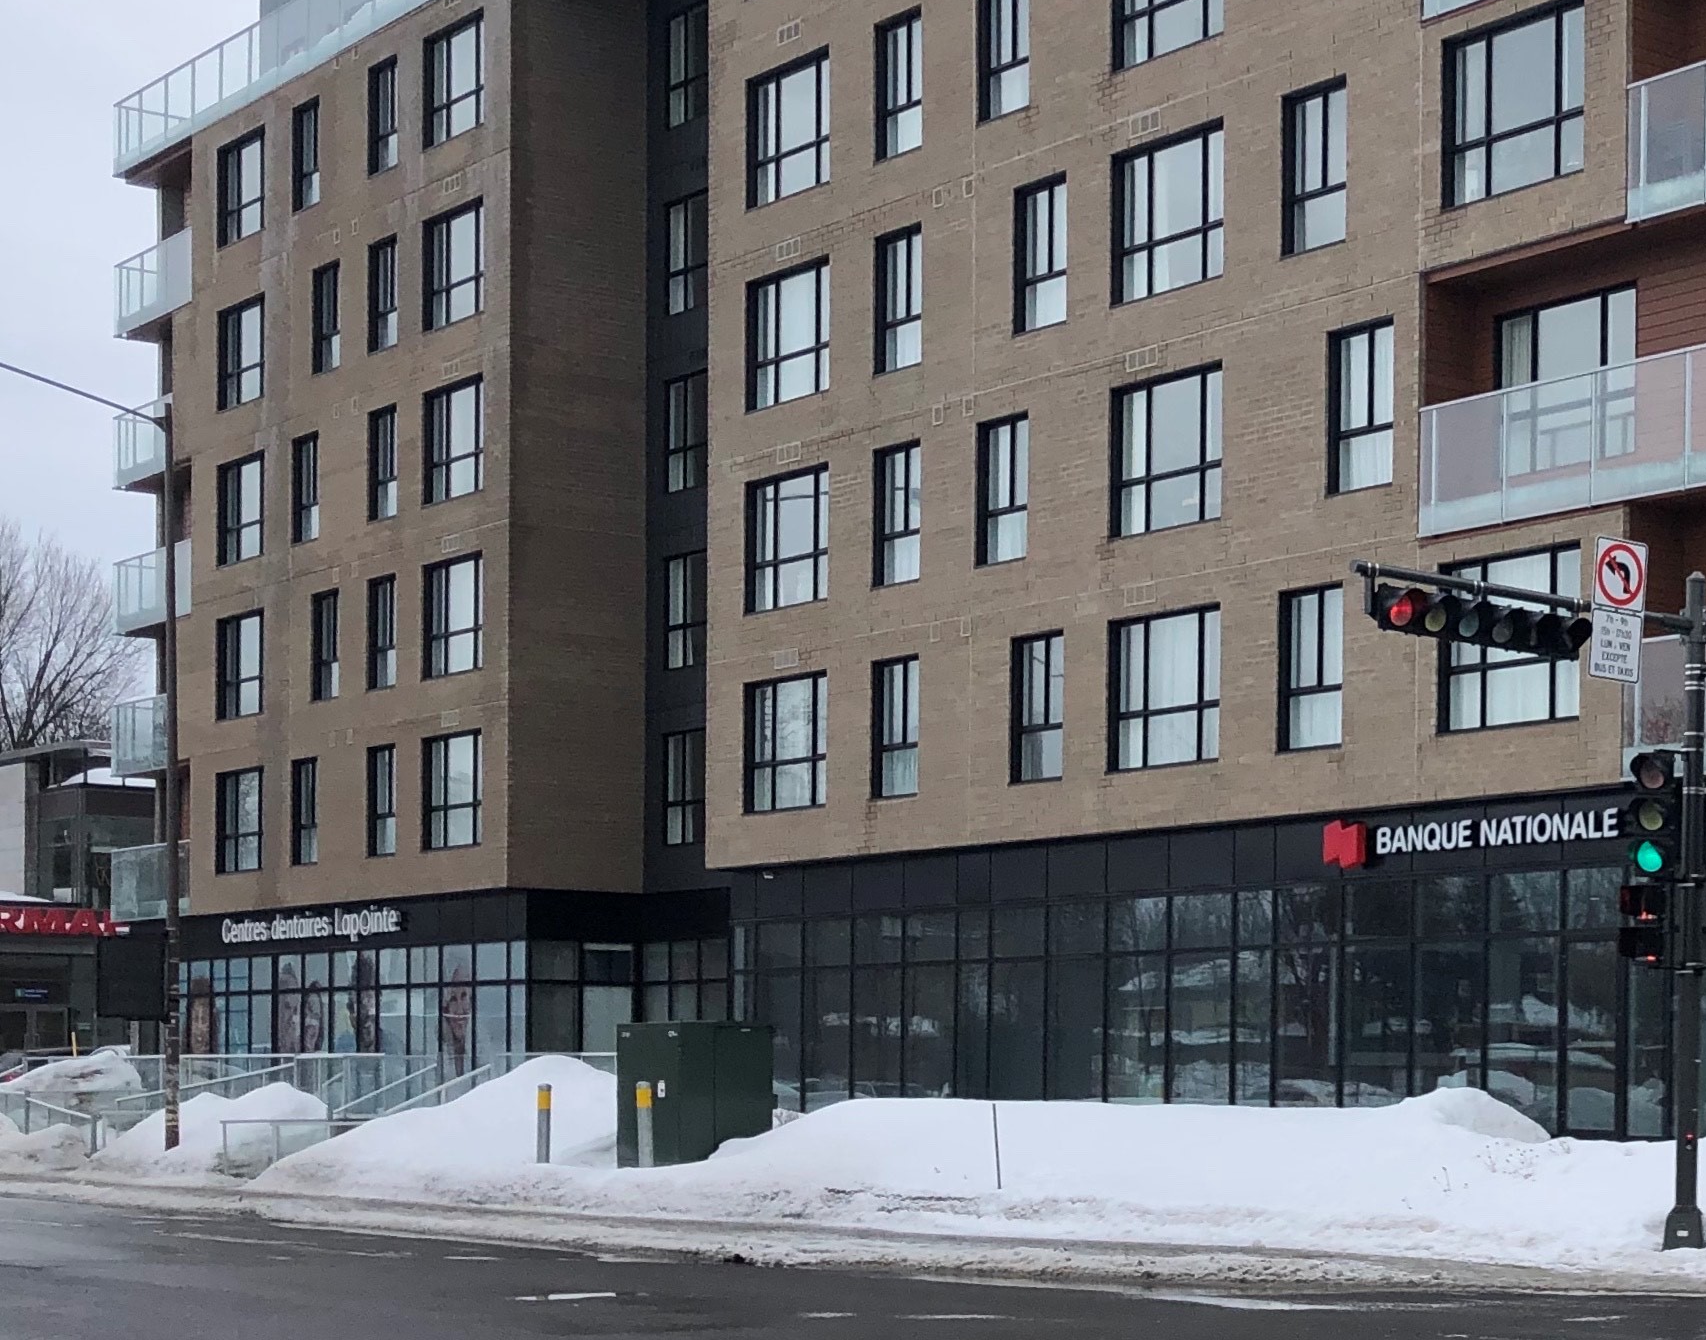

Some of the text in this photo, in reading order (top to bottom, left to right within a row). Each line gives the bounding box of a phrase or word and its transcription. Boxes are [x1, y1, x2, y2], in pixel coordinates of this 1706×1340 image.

[1375, 807, 1620, 855] BANQUE NATIONALE
[222, 905, 400, 944] Centres dentaires Lapointe
